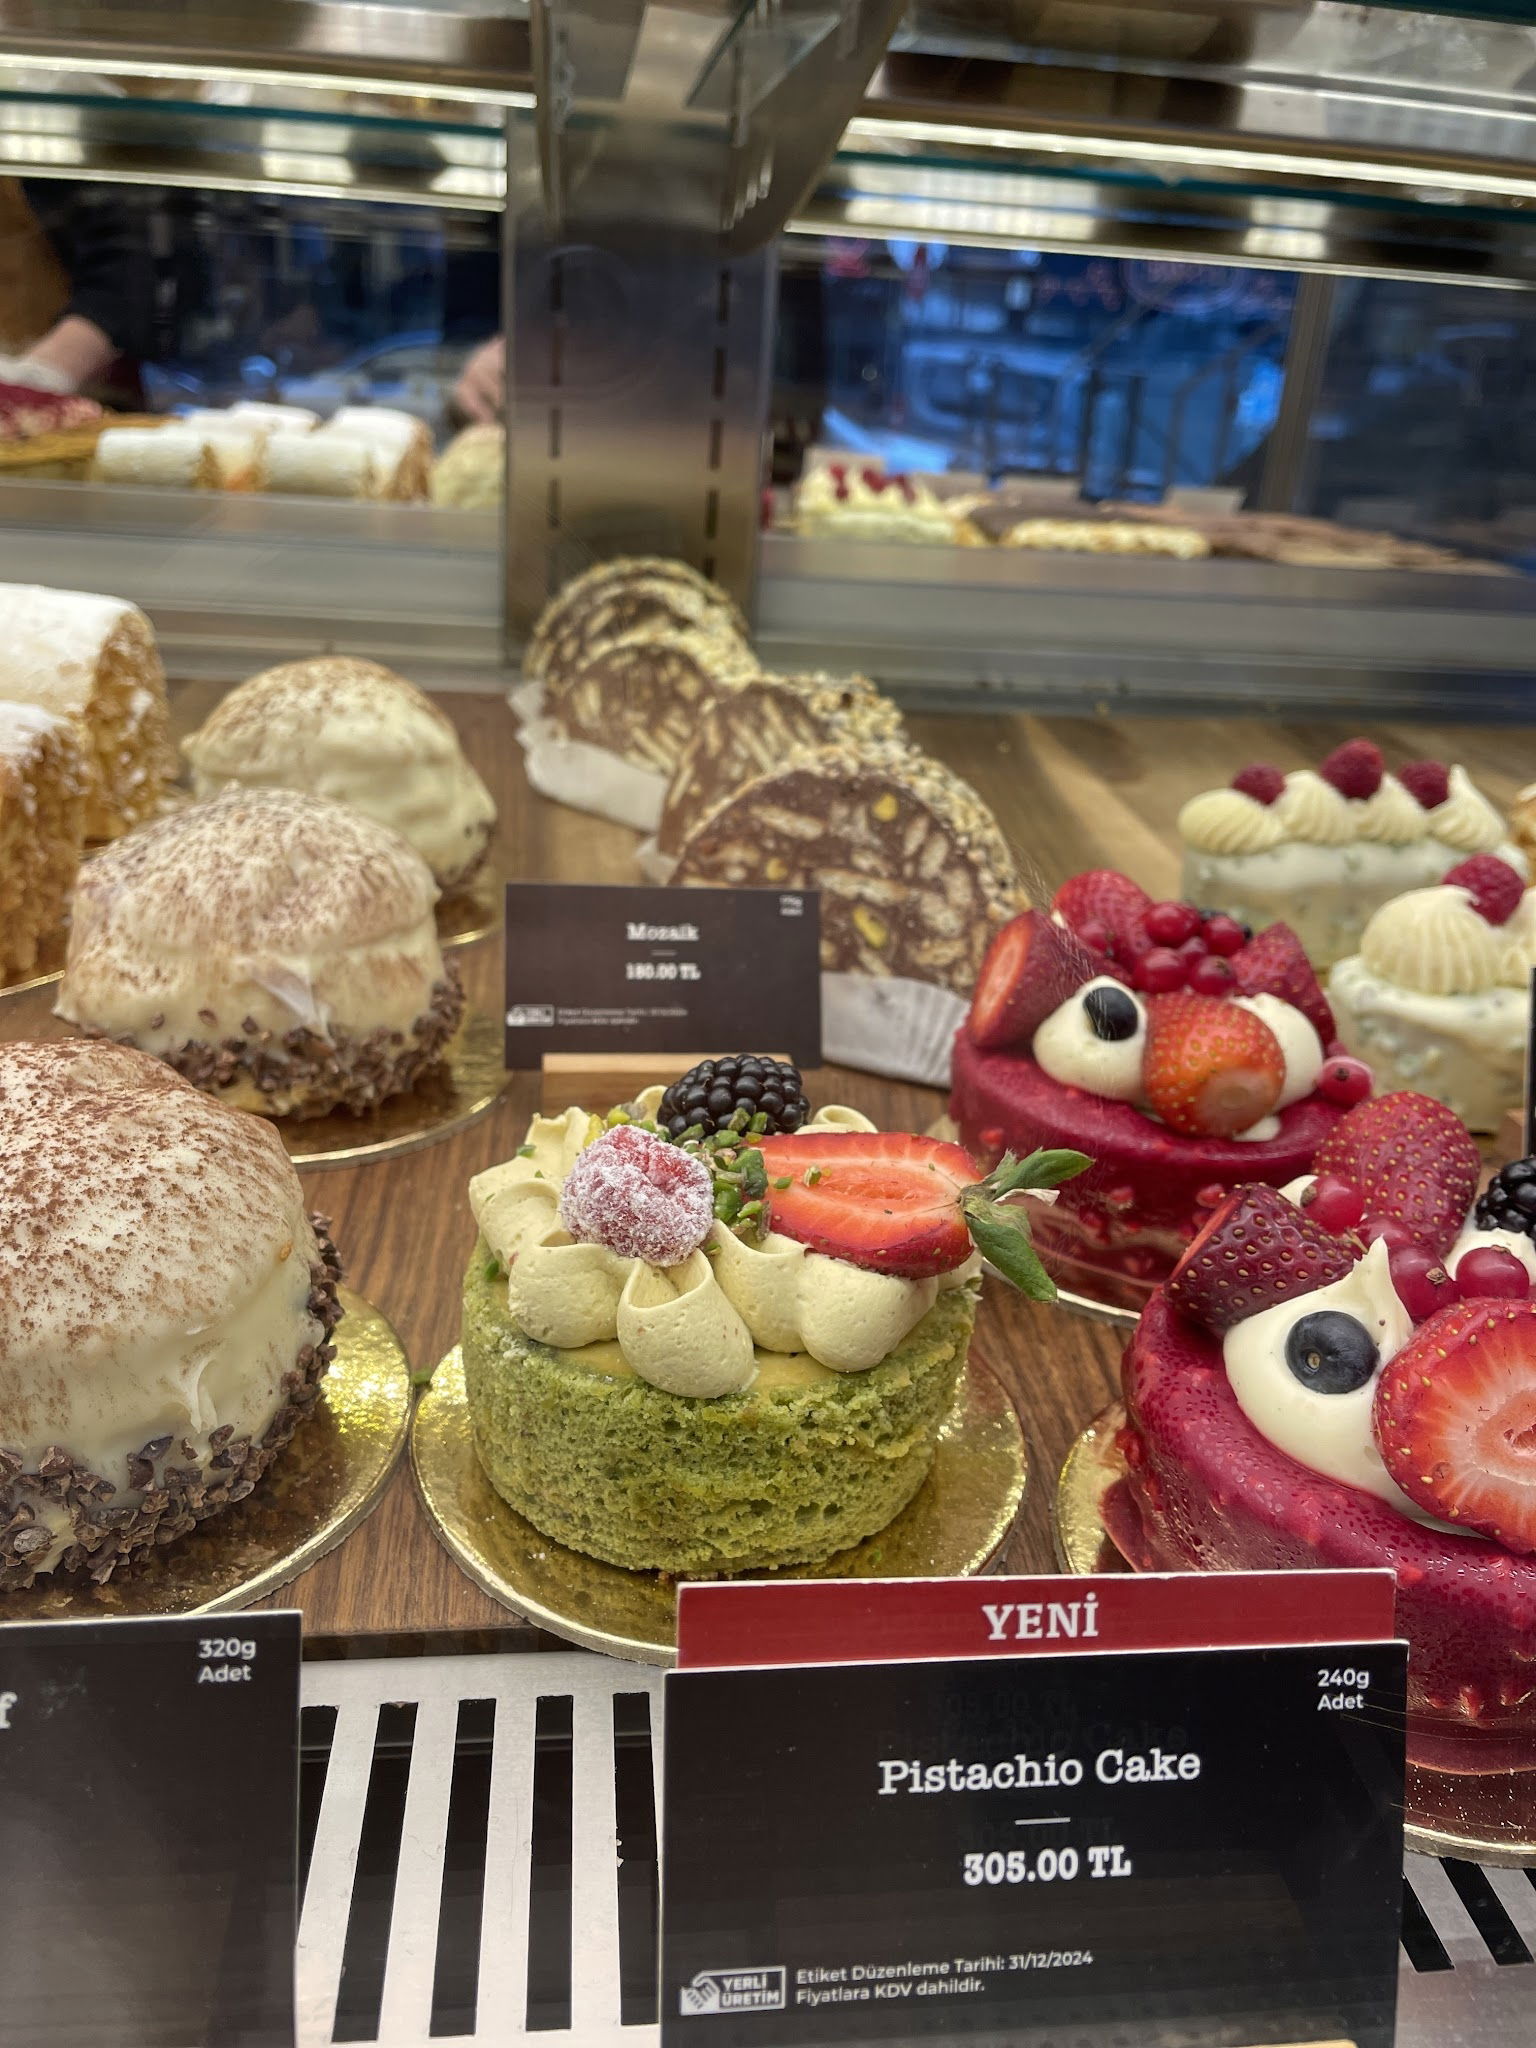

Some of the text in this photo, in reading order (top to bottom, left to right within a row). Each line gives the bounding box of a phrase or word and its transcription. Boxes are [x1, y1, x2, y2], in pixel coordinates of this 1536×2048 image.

[626, 922, 699, 941] Mozaik
[680, 962, 702, 980] TL
[982, 1592, 1099, 1640] YENİ
[198, 1638, 256, 1661] 320g
[198, 1665, 252, 1683] Adet
[1317, 1668, 1370, 1690] 240g
[1317, 1693, 1364, 1711] Adet
[878, 1748, 1201, 1795] Pistachio Cake
[963, 1845, 1132, 1886] 305.00 TL
[796, 1950, 1093, 1985] Etiket Düzenleme Tarihi: 31/12/2024
[722, 1973, 767, 1991] YERLİ
[796, 1976, 985, 2007] Fiyatlara KDV dahildir.
[721, 1989, 779, 2008] ÜRETİM
